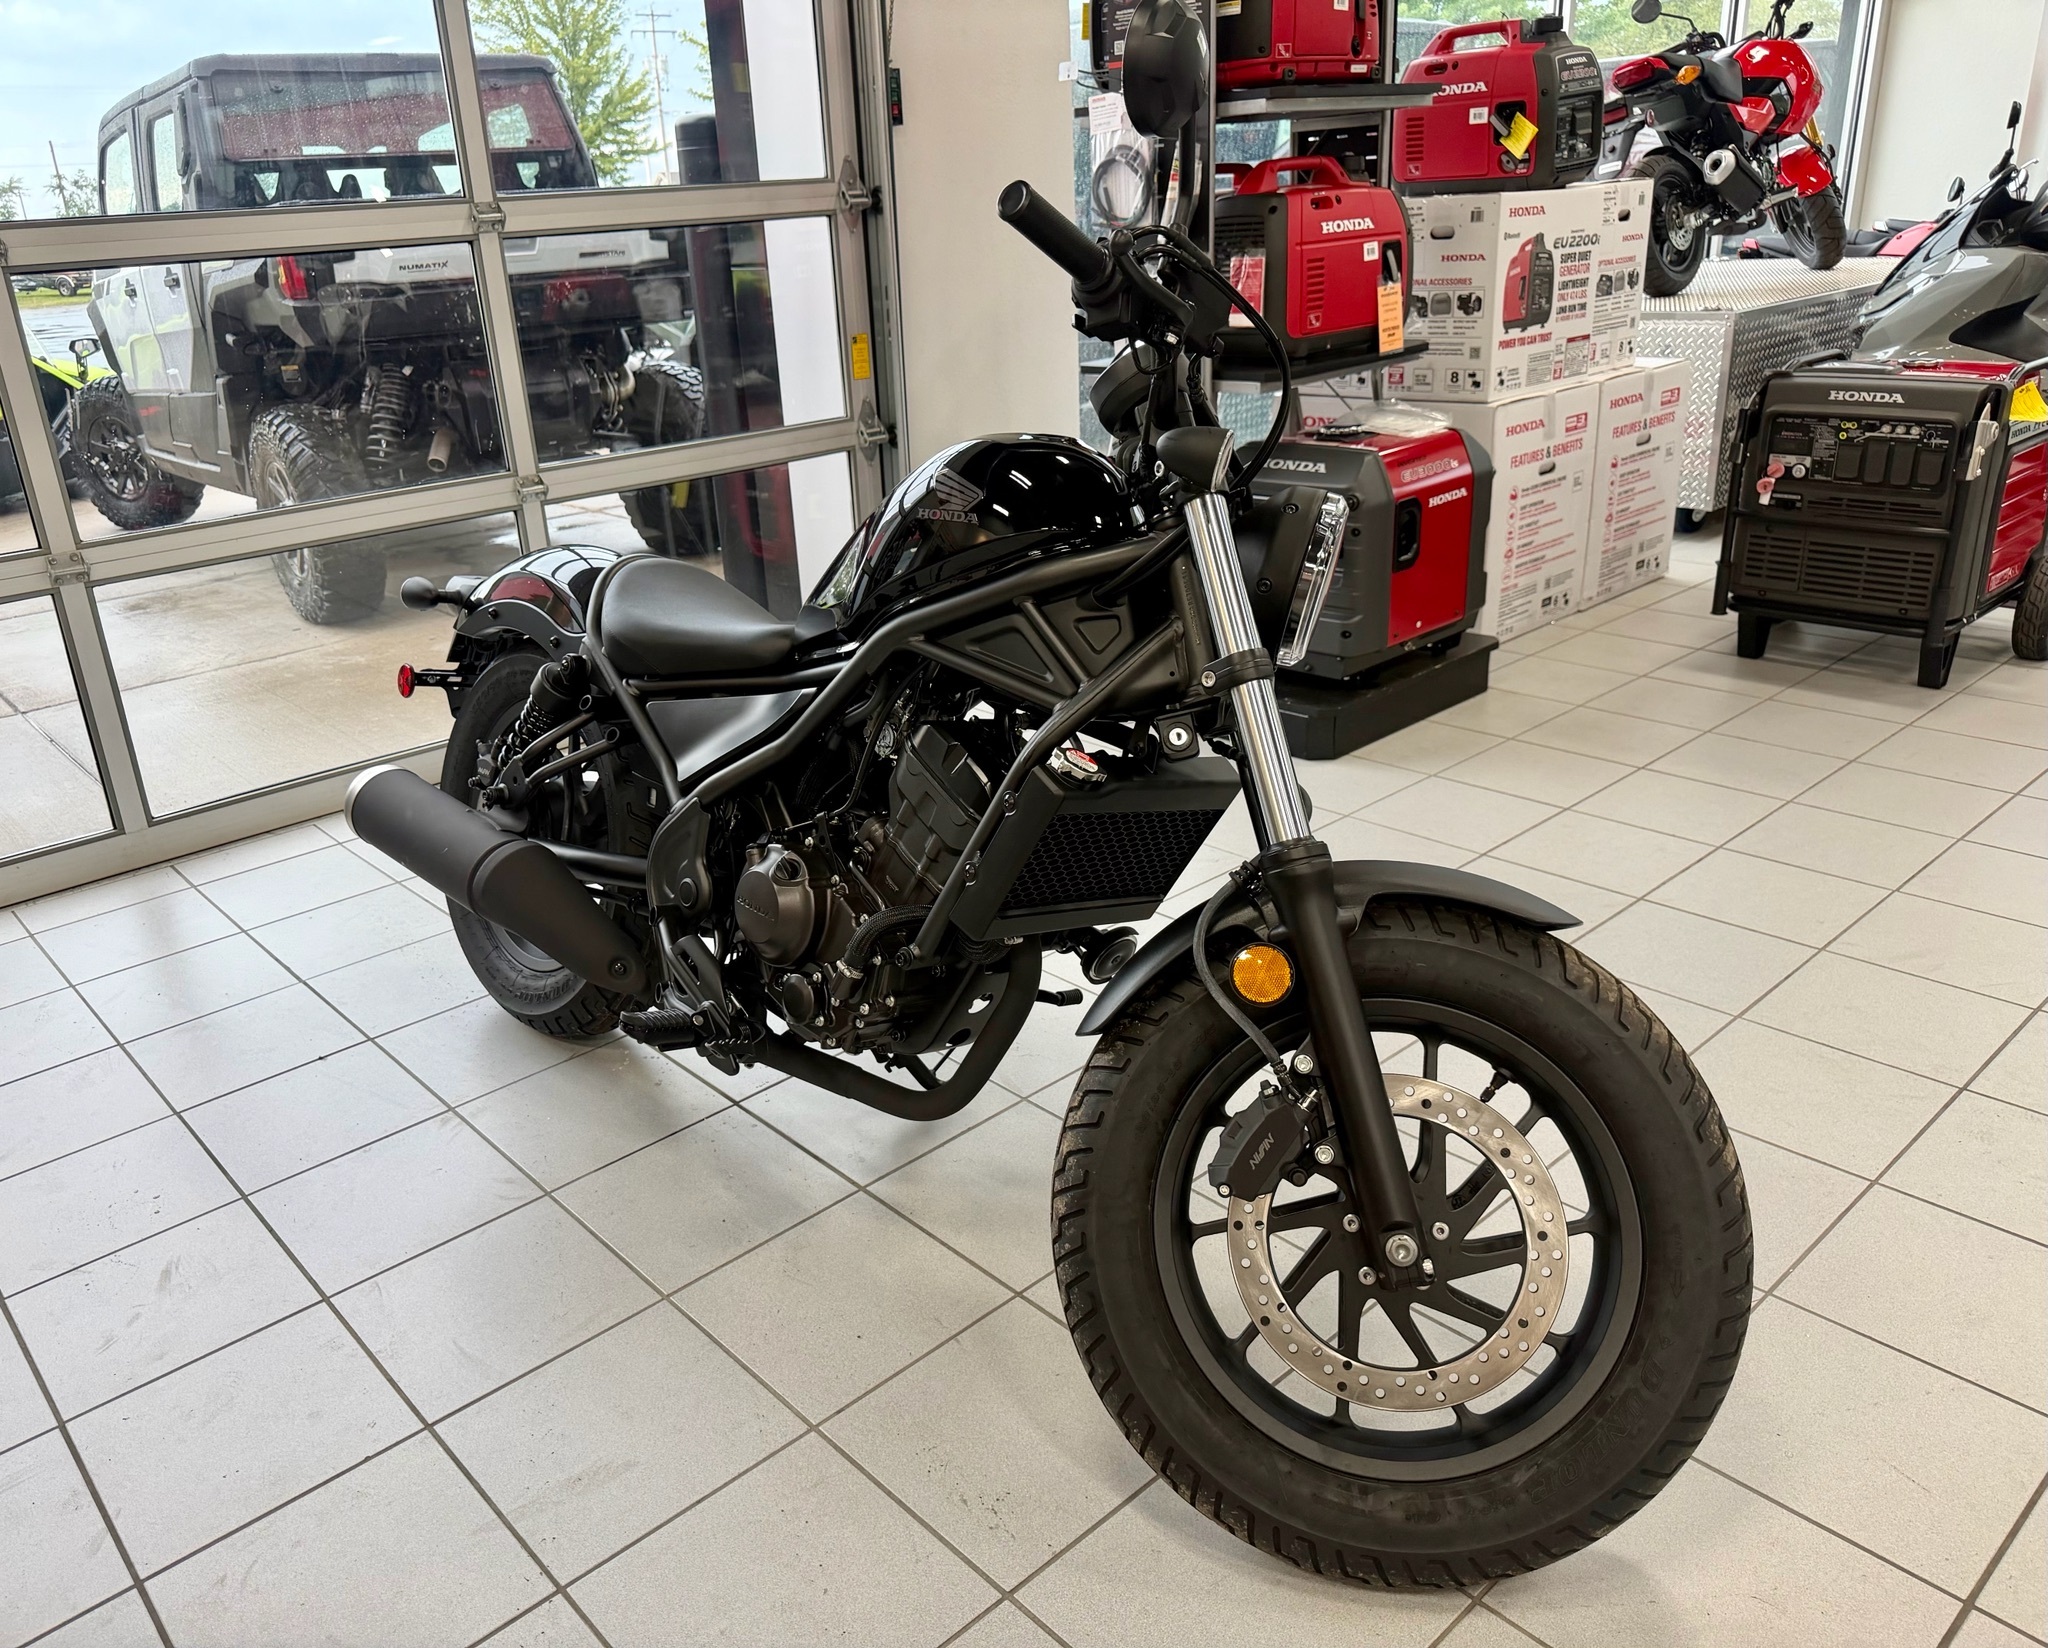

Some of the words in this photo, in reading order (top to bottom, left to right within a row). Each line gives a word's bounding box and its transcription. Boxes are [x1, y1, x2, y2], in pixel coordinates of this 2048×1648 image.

[1565, 56, 1588, 65] HONDA
[1433, 81, 1488, 96] ONDA
[1508, 205, 1546, 218] HONDA
[1320, 217, 1375, 234] HONDA
[1553, 233, 1601, 249] EU2200i
[1622, 233, 1644, 242] HONDA
[1441, 253, 1486, 262] HONDA
[1560, 252, 1576, 264] SUPER
[1577, 250, 1591, 263] QUIET
[399, 260, 449, 271] NUMATIX
[1559, 262, 1590, 277] GENERATOR
[1429, 277, 1473, 286] ACCESSORIES
[1498, 337, 1516, 350] POWER
[1517, 337, 1526, 347] YOU
[1527, 335, 1537, 346] CAN
[1538, 332, 1552, 344] TRUST
[1450, 371, 1459, 384] 8
[1609, 393, 1644, 410] HONDA
[1828, 390, 1905, 404] HONDA
[1506, 418, 1545, 437] HONDA
[1612, 420, 1642, 439] FEATURES
[1642, 418, 1647, 430] &
[1648, 411, 1675, 429] BENEFITS
[1510, 448, 1544, 469] FEATURES
[1545, 446, 1551, 459] &
[1552, 438, 1583, 457] BENEFITS
[1428, 487, 1468, 508] HONDA
[917, 507, 979, 525] HONDA
